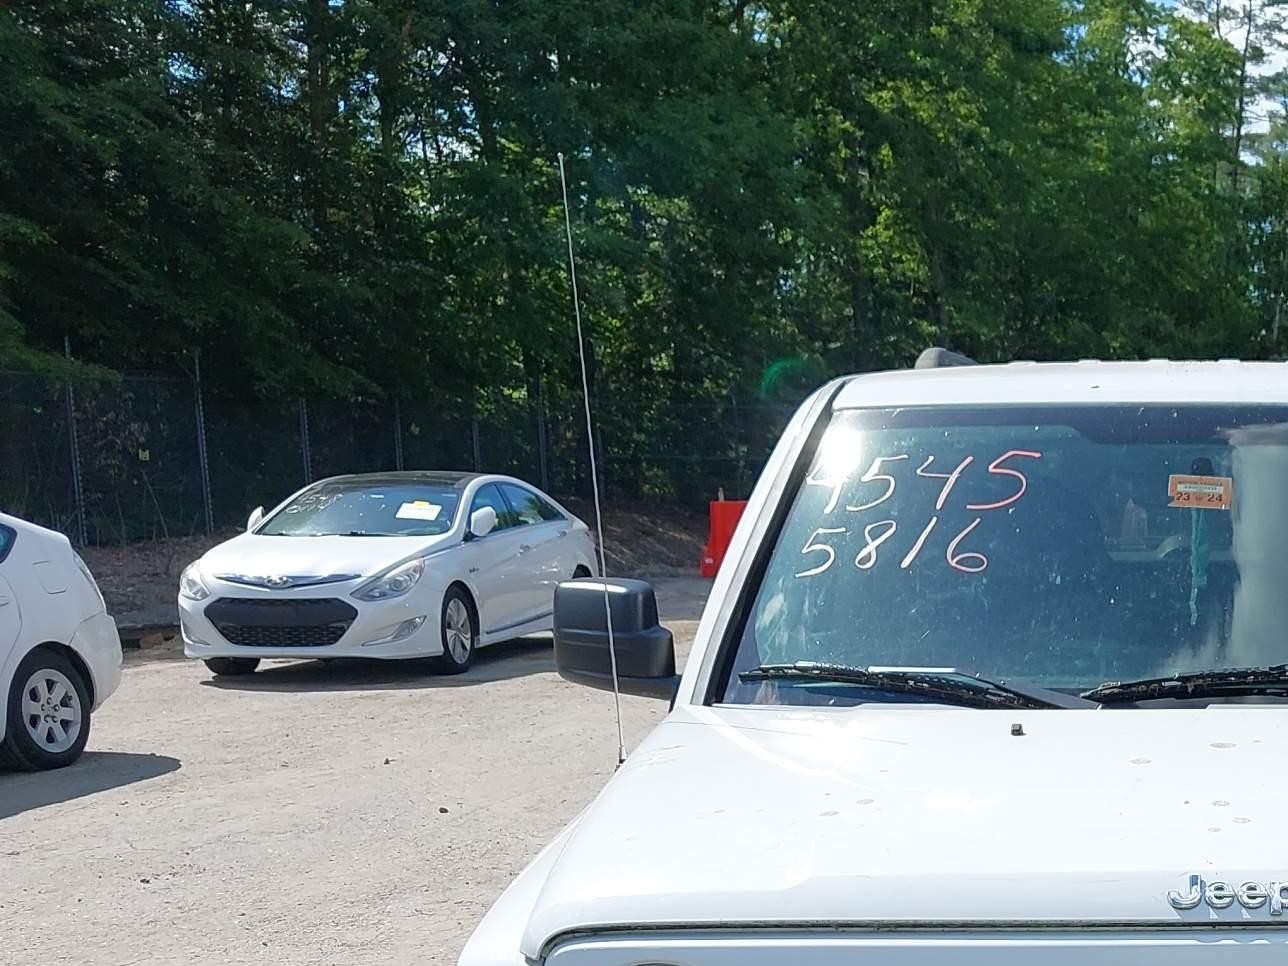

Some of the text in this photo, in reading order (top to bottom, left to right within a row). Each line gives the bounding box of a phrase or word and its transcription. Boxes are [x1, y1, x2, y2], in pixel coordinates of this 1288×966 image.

[805, 450, 1042, 514] 4545
[1175, 492, 1191, 502] 23
[1207, 493, 1223, 503] 24
[795, 516, 988, 578] 5816
